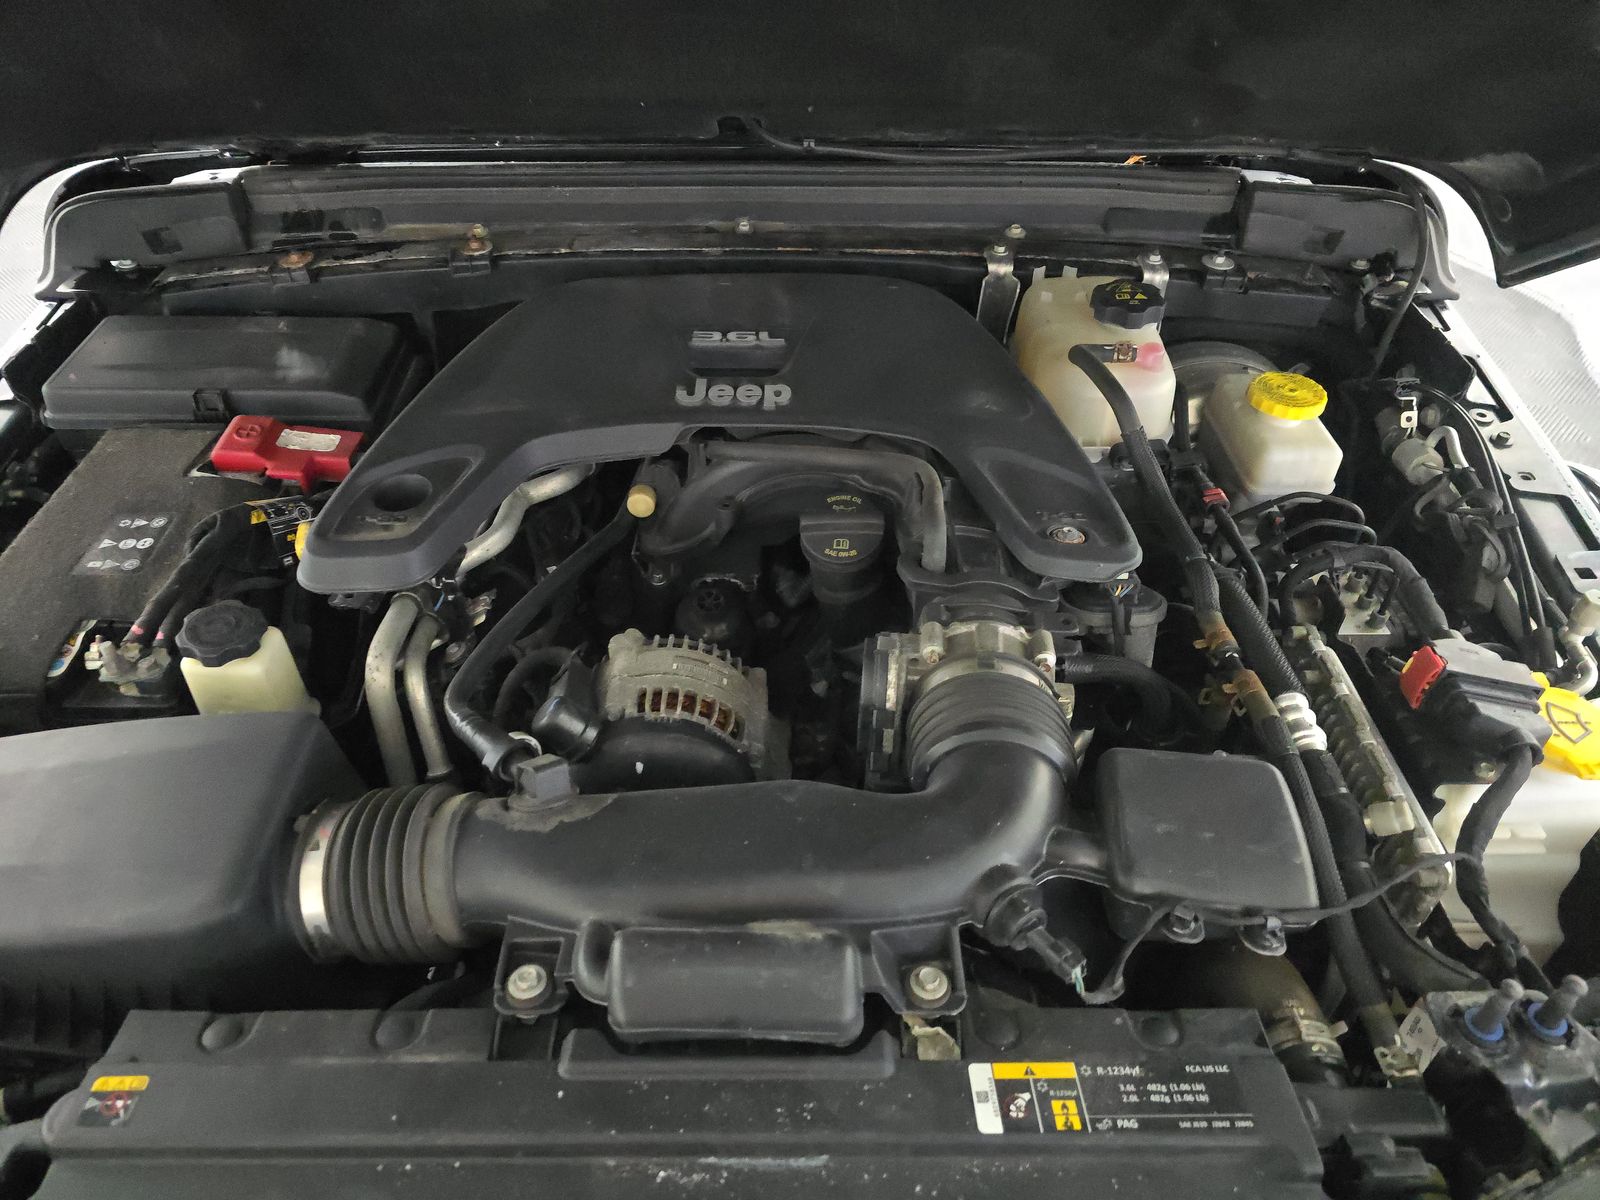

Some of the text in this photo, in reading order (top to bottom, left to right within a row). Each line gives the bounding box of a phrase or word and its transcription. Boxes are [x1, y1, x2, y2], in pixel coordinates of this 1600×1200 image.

[690, 330, 786, 346] 3.6L
[675, 378, 792, 410] Jeep
[827, 495, 862, 505] ENGINE OIL
[1096, 1065, 1140, 1077] R-1234yf
[1116, 1118, 1139, 1129] PAG
